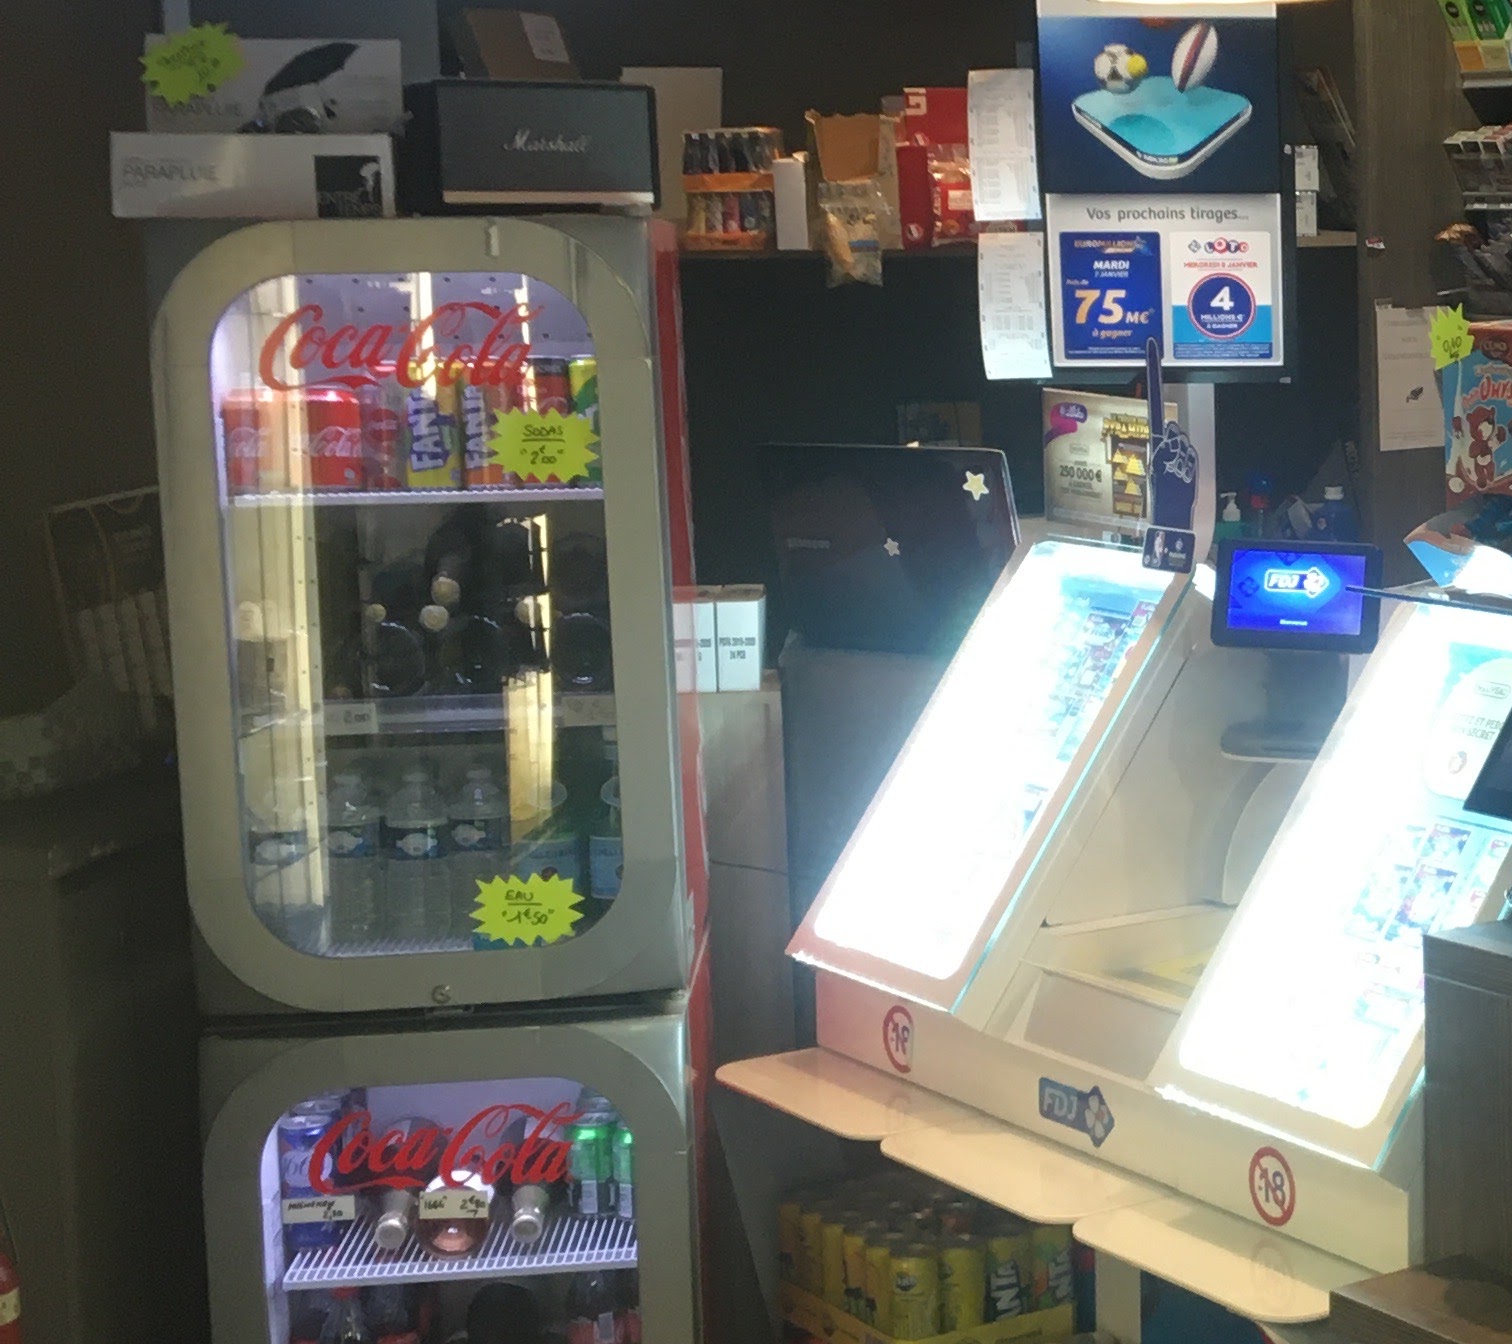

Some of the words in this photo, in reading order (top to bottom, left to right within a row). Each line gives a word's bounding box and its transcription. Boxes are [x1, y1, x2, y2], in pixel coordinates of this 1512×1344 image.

[503, 128, 591, 155] Marshall
[1087, 208, 1111, 220] Vos
[1118, 206, 1186, 223] prochains
[1204, 237, 1249, 254] LOTO
[1093, 260, 1130, 270] MARDI
[1184, 261, 1220, 269] MERCREDI
[1227, 261, 1258, 269] JANVIER
[1099, 270, 1130, 278] JANVIER
[1210, 285, 1235, 312] 4
[1073, 289, 1127, 325] 75
[1200, 313, 1236, 322] MILLIONS
[1100, 329, 1133, 340] gagner
[523, 425, 564, 436] SODAS
[1060, 464, 1076, 478] 250
[1077, 467, 1094, 482] 000
[1268, 572, 1300, 588] FDJ
[505, 889, 534, 901] EAU
[1043, 1086, 1078, 1121] FDJ
